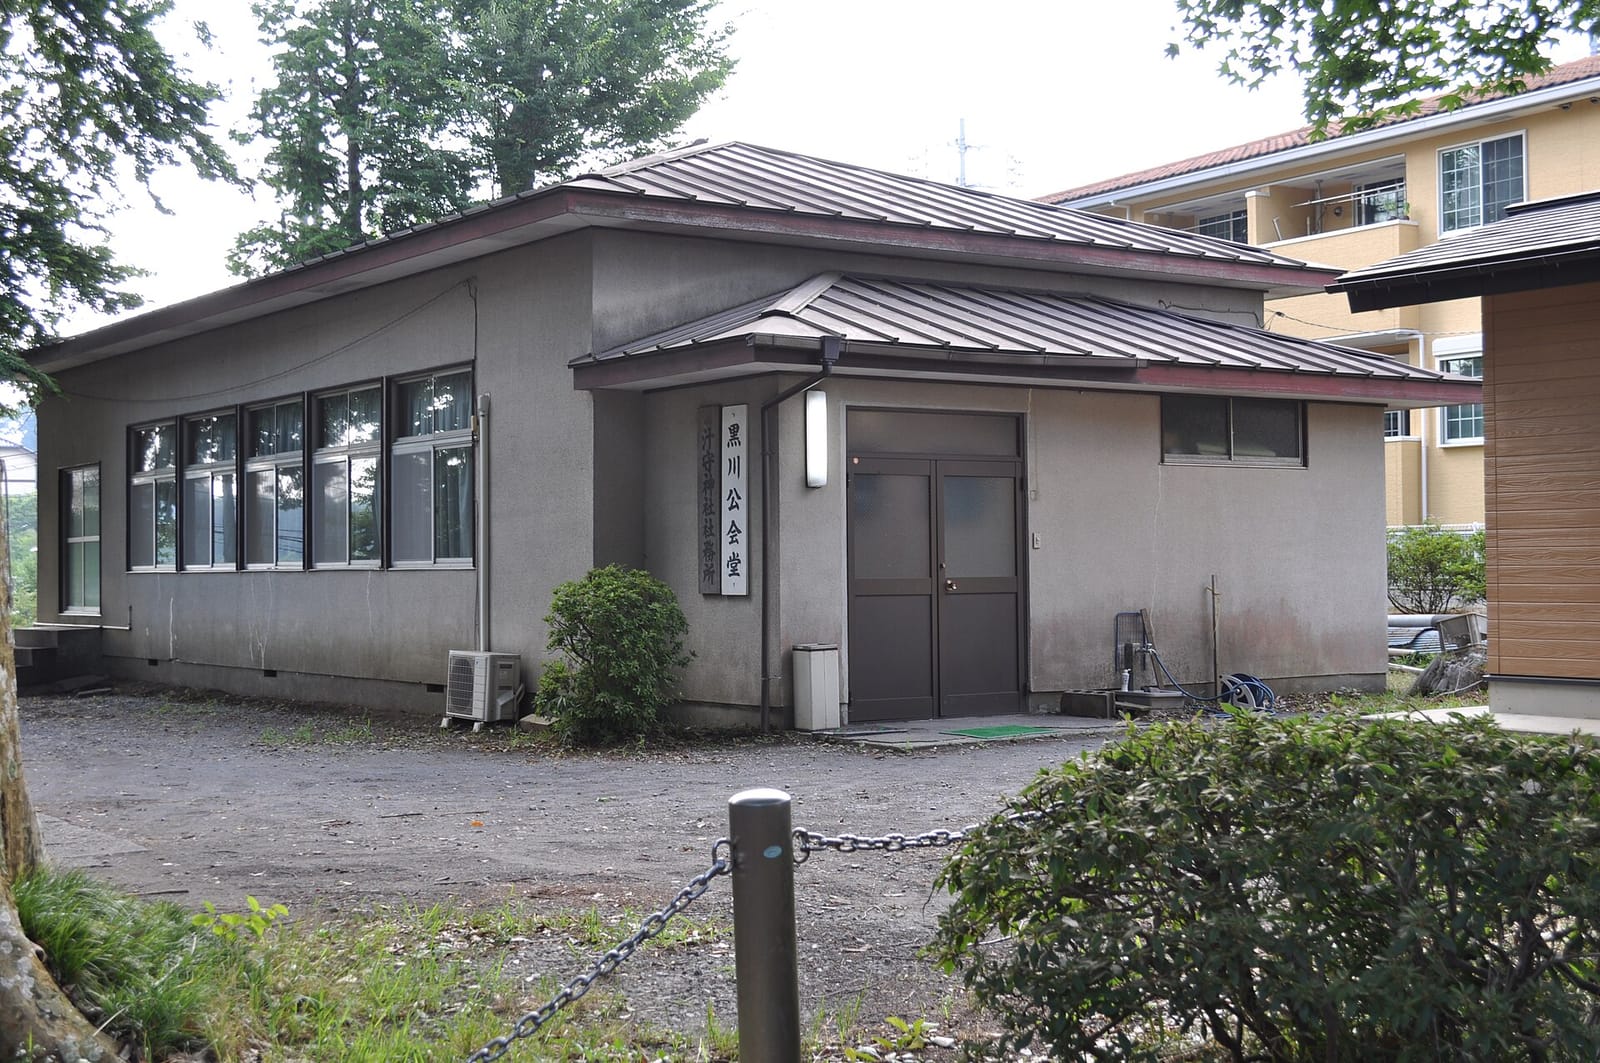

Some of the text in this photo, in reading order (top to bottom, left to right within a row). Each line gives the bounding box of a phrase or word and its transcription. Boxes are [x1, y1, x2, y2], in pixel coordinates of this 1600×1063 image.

[726, 423, 742, 577] 黒川公会堂
